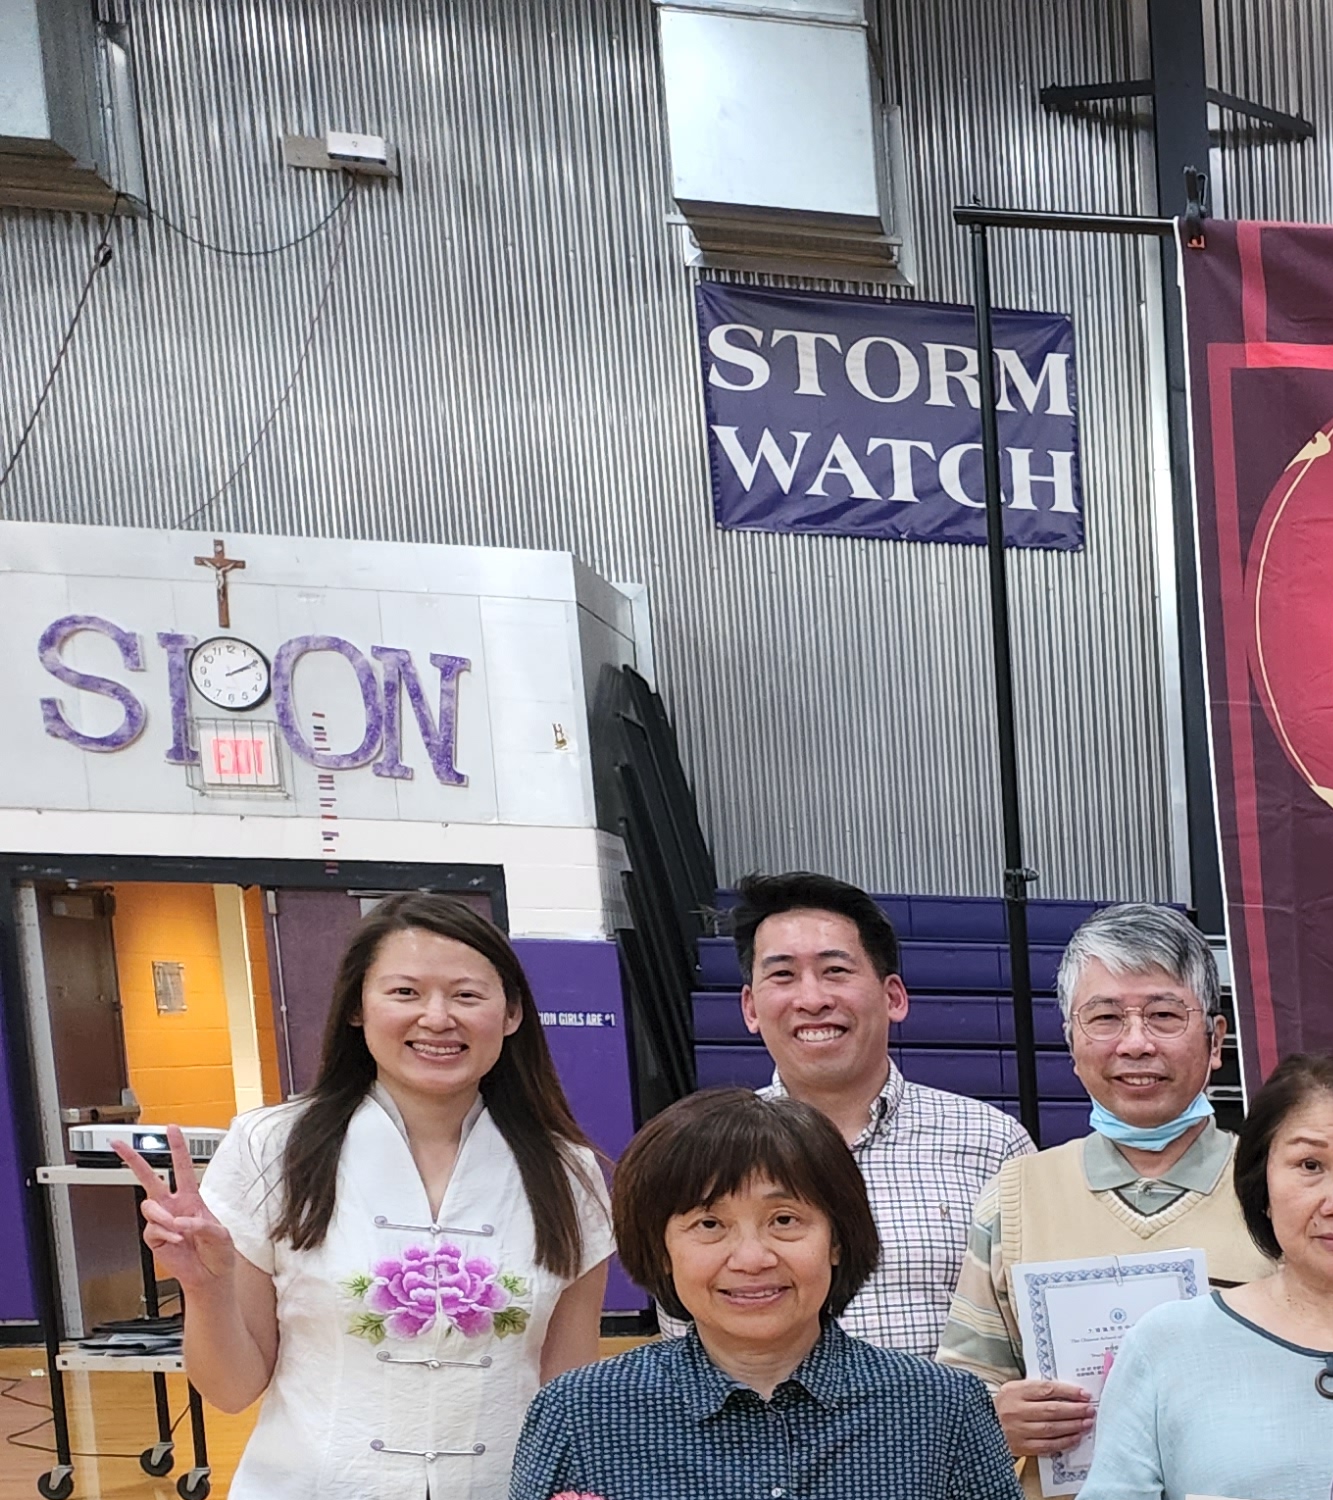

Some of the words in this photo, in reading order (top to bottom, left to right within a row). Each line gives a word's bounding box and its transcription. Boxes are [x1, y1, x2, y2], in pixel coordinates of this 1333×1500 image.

[708, 324, 1074, 416] STORM
[710, 424, 1081, 514] WATCH
[211, 738, 264, 775] EXIT
[558, 1012, 585, 1027] GIRLS
